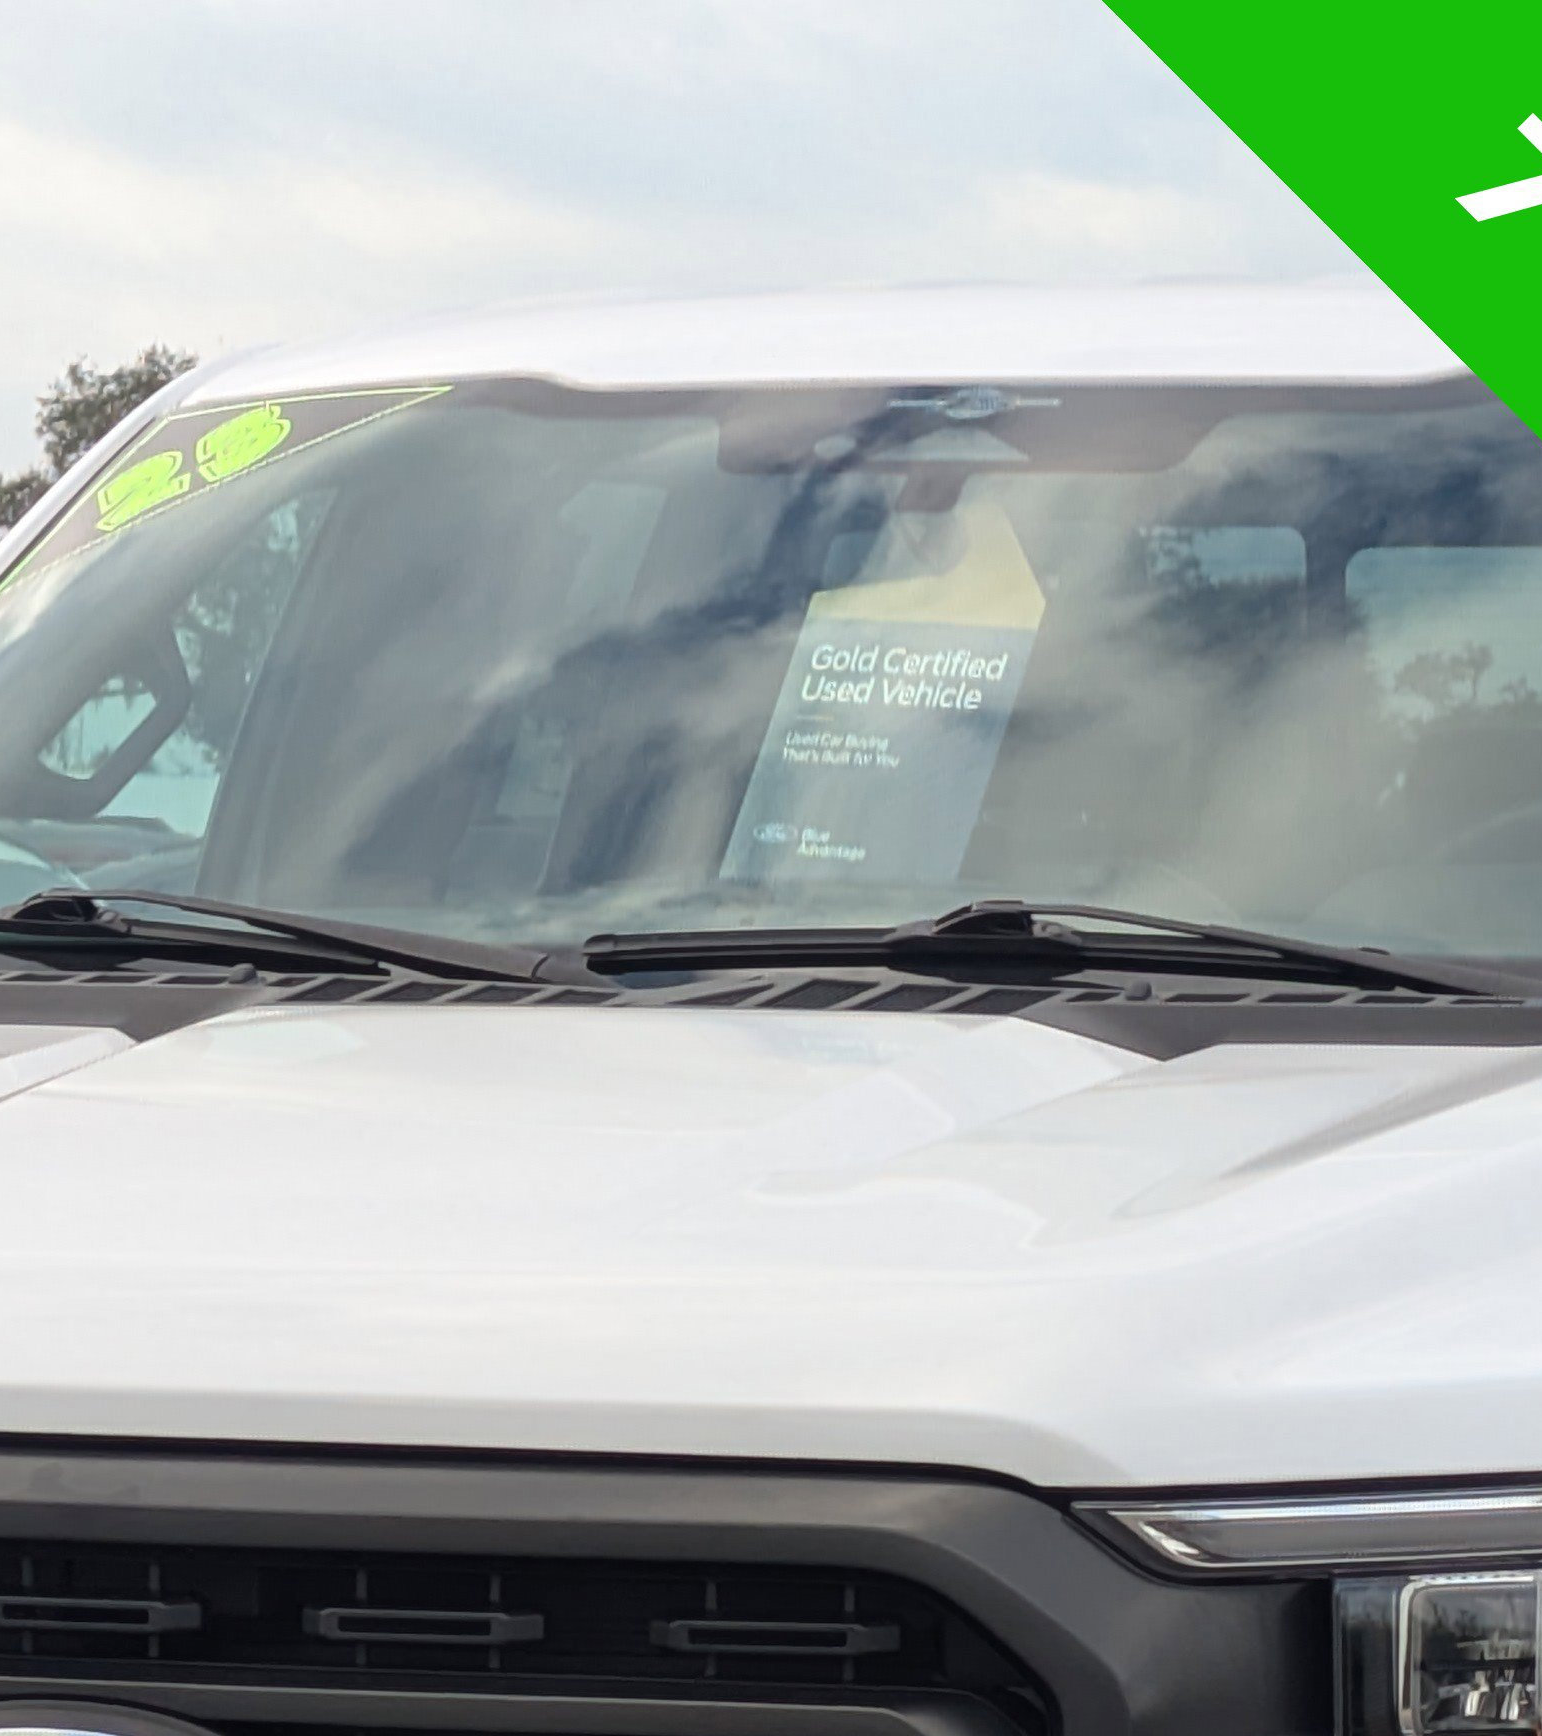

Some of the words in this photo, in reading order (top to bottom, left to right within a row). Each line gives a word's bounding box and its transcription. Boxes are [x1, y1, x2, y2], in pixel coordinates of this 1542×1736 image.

[811, 643, 880, 672] Gold
[883, 646, 1008, 682] Certified
[801, 675, 876, 704] Used
[883, 678, 982, 710] Vehicle
